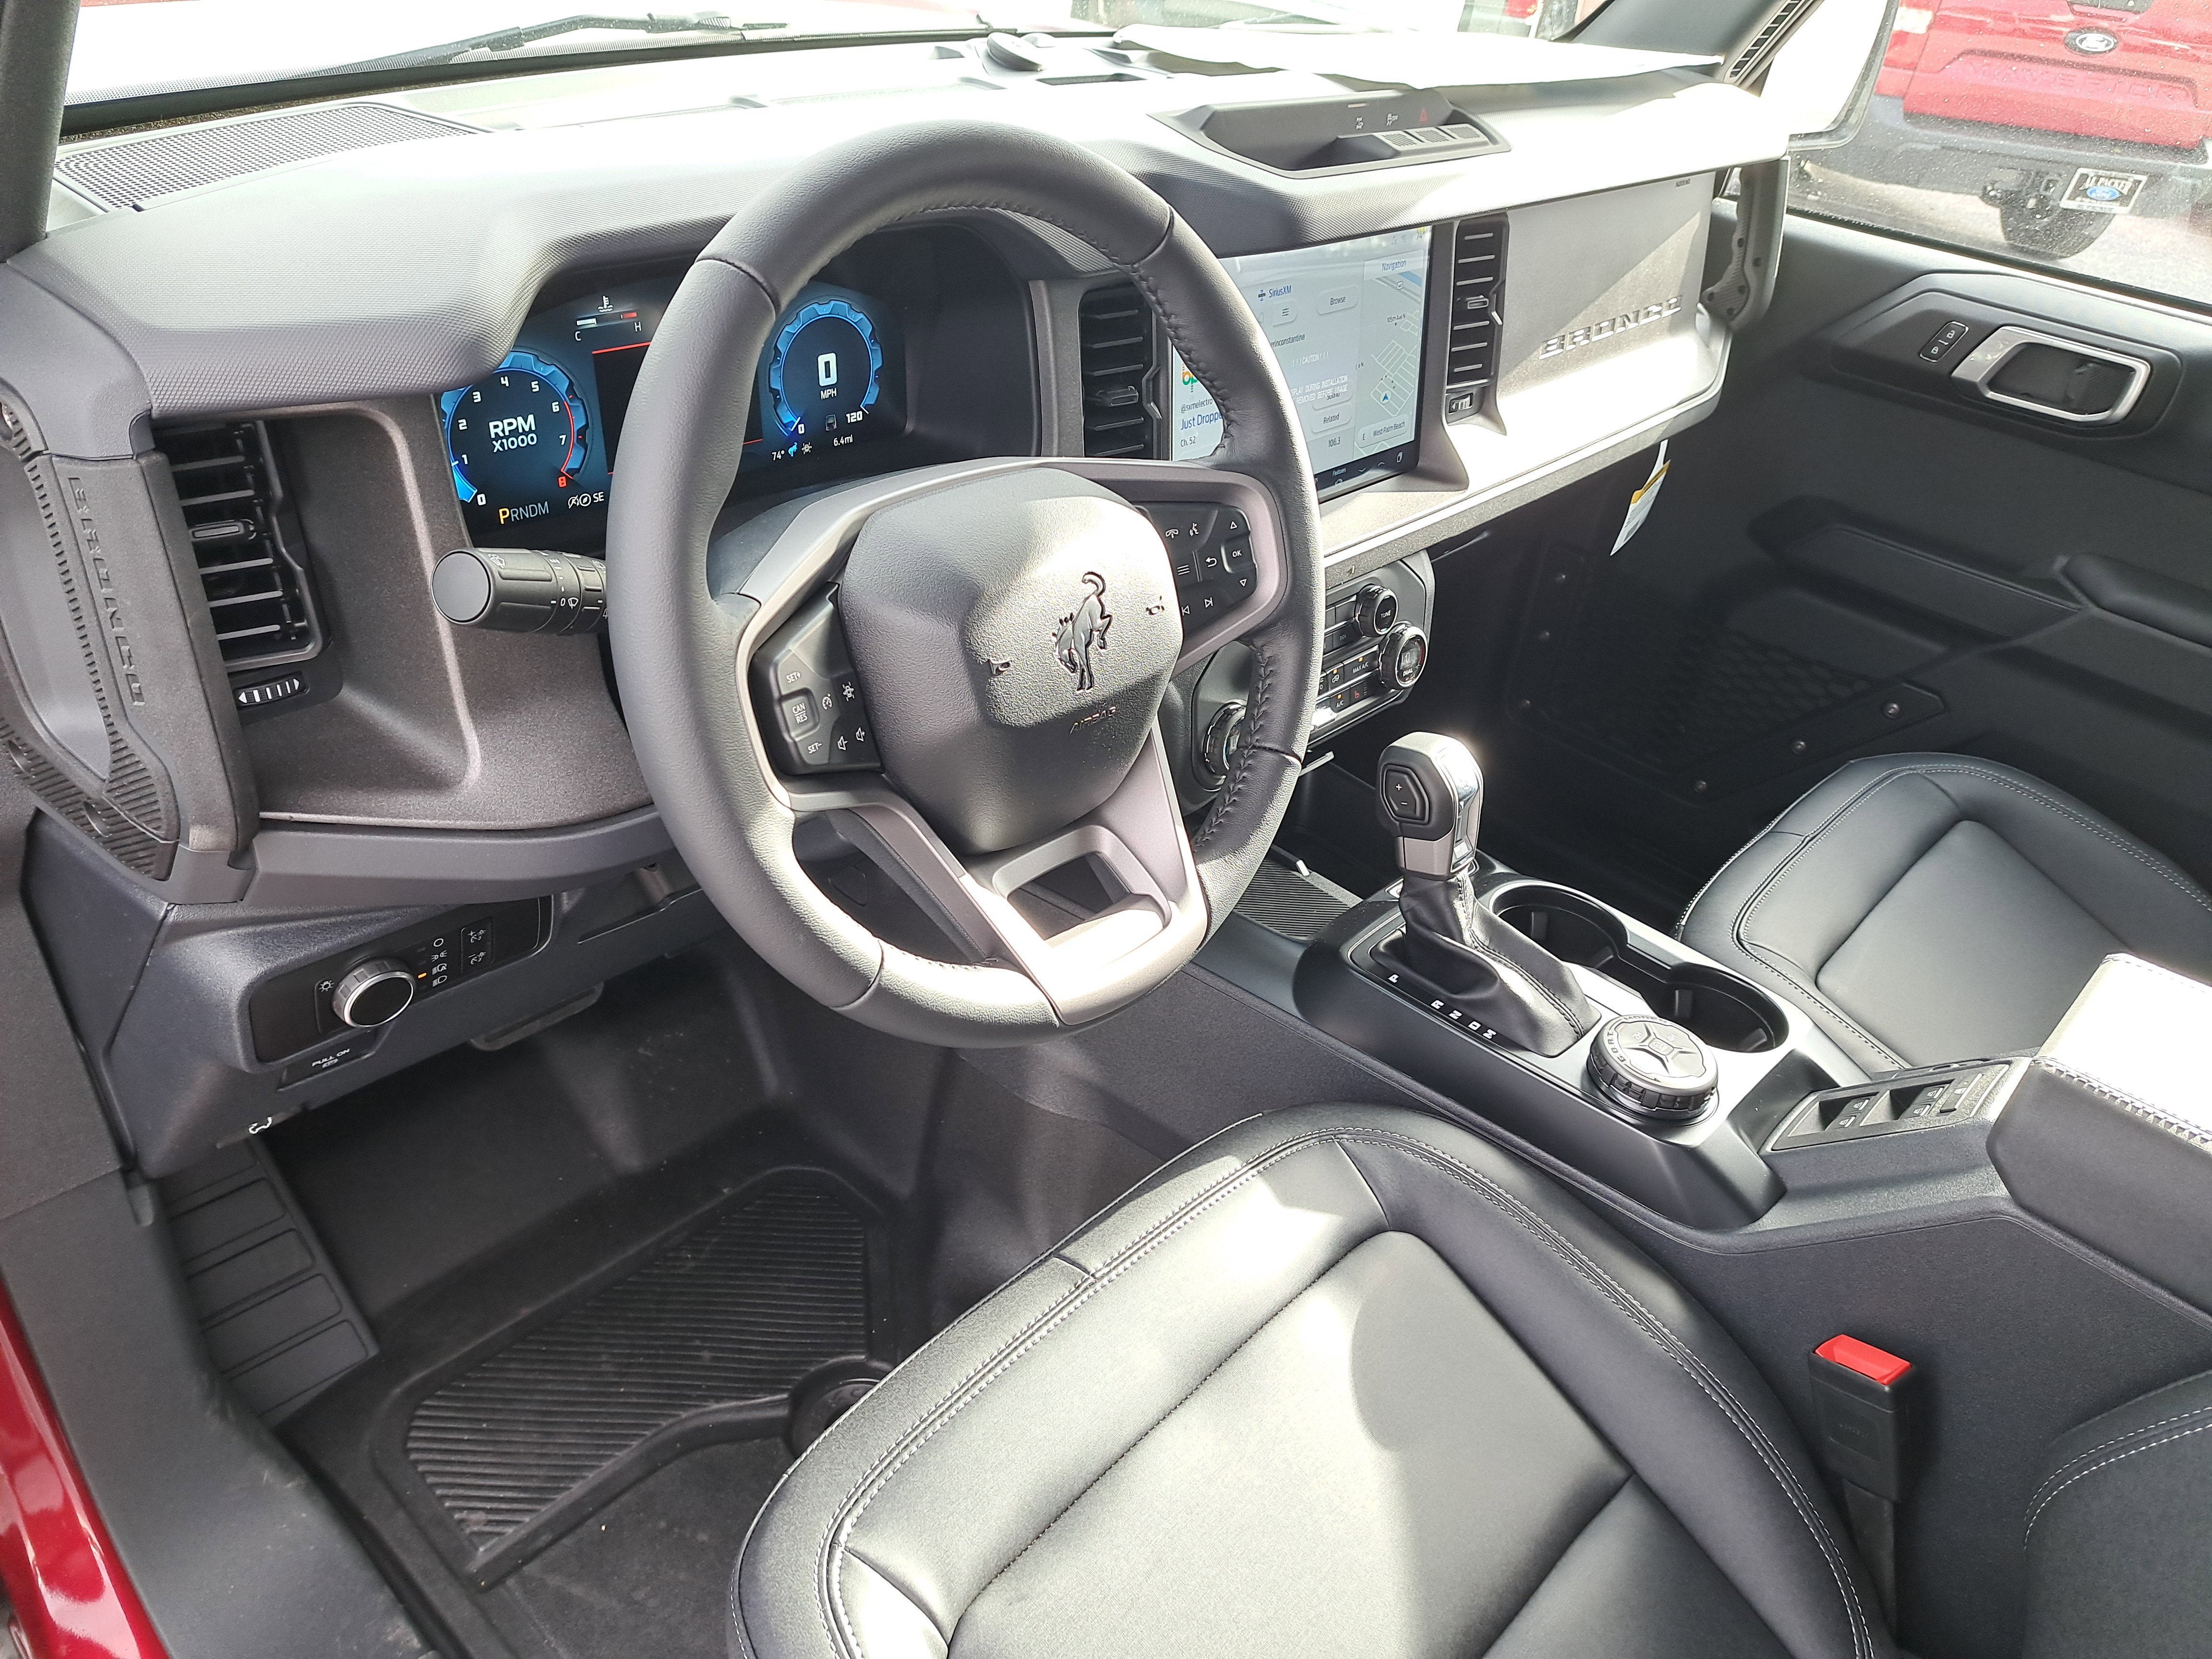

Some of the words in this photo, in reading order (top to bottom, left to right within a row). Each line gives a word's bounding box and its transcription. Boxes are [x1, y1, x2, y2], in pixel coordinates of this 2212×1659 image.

[1382, 260, 1406, 271] Navigation
[1269, 285, 1291, 298] SiriusXM
[1330, 297, 1346, 305] Browse
[634, 321, 642, 332] H
[1538, 295, 1683, 359] BRONCO
[575, 331, 581, 341] C
[818, 352, 837, 387] 0
[501, 376, 509, 387] 4
[531, 381, 540, 392] 5
[473, 391, 481, 402] 3
[820, 388, 837, 400] MPH
[1296, 393, 1316, 404] REMOVED
[552, 402, 560, 412] 6
[1181, 398, 1213, 413] @sxmelectro
[846, 411, 863, 423] 120
[1323, 413, 1339, 424] Related
[458, 419, 467, 430] 2
[488, 414, 536, 439] RPM
[798, 424, 805, 434] 0
[1181, 416, 1195, 431] Just
[1394, 421, 1405, 430] Beach
[492, 433, 537, 453] X1000
[559, 435, 567, 445] 7
[1190, 436, 1196, 445] 52
[1328, 437, 1340, 448] 106.3
[462, 454, 468, 465] 1
[558, 476, 567, 487] 8
[476, 494, 486, 505] 0
[593, 492, 605, 502] SE
[68, 477, 144, 706] BRONCO
[1381, 610, 1391, 619] TUNE
[1352, 664, 1362, 674] MAX
[1403, 668, 1413, 677] DUAL
[786, 672, 801, 683] SET+
[792, 703, 806, 713] CAN
[796, 713, 808, 724] RES
[807, 742, 822, 754] SET-
[1388, 974, 1399, 983] P
[1431, 1000, 1444, 1009] R
[1449, 1010, 1462, 1020] N
[1468, 1021, 1481, 1030] D
[1483, 1029, 1497, 1039] M
[312, 1055, 334, 1067] PULL
[336, 1048, 350, 1057] ON
